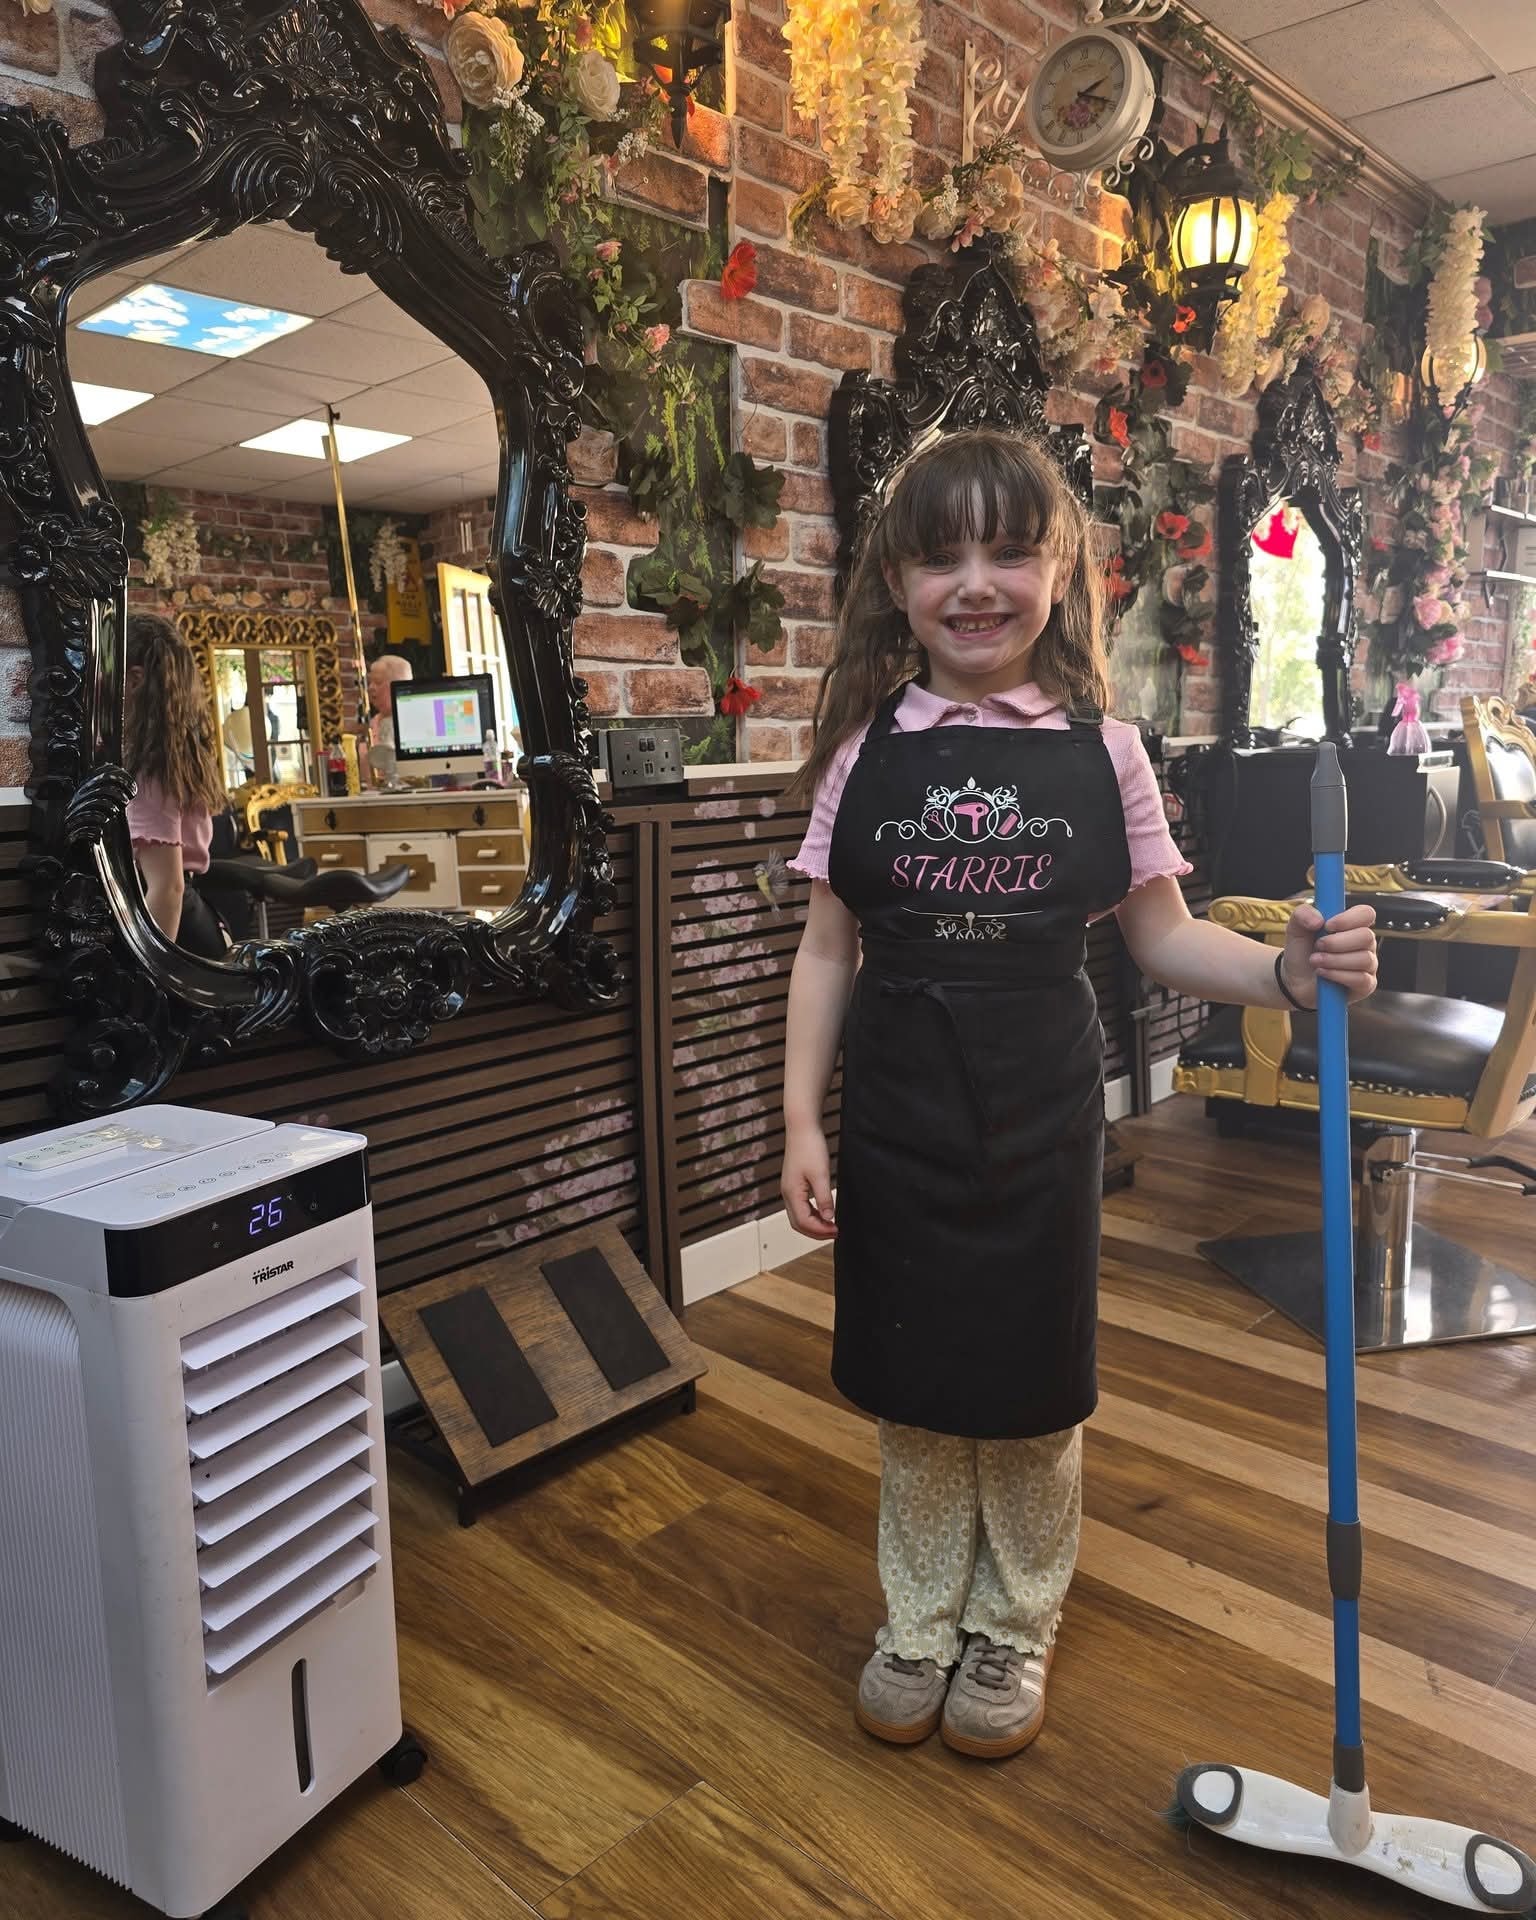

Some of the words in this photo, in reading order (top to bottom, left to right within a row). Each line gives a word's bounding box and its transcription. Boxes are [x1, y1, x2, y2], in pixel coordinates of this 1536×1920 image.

[891, 853, 1053, 895] STARRIE
[249, 1196, 283, 1236] 26
[252, 1260, 294, 1285] TRISTAR
